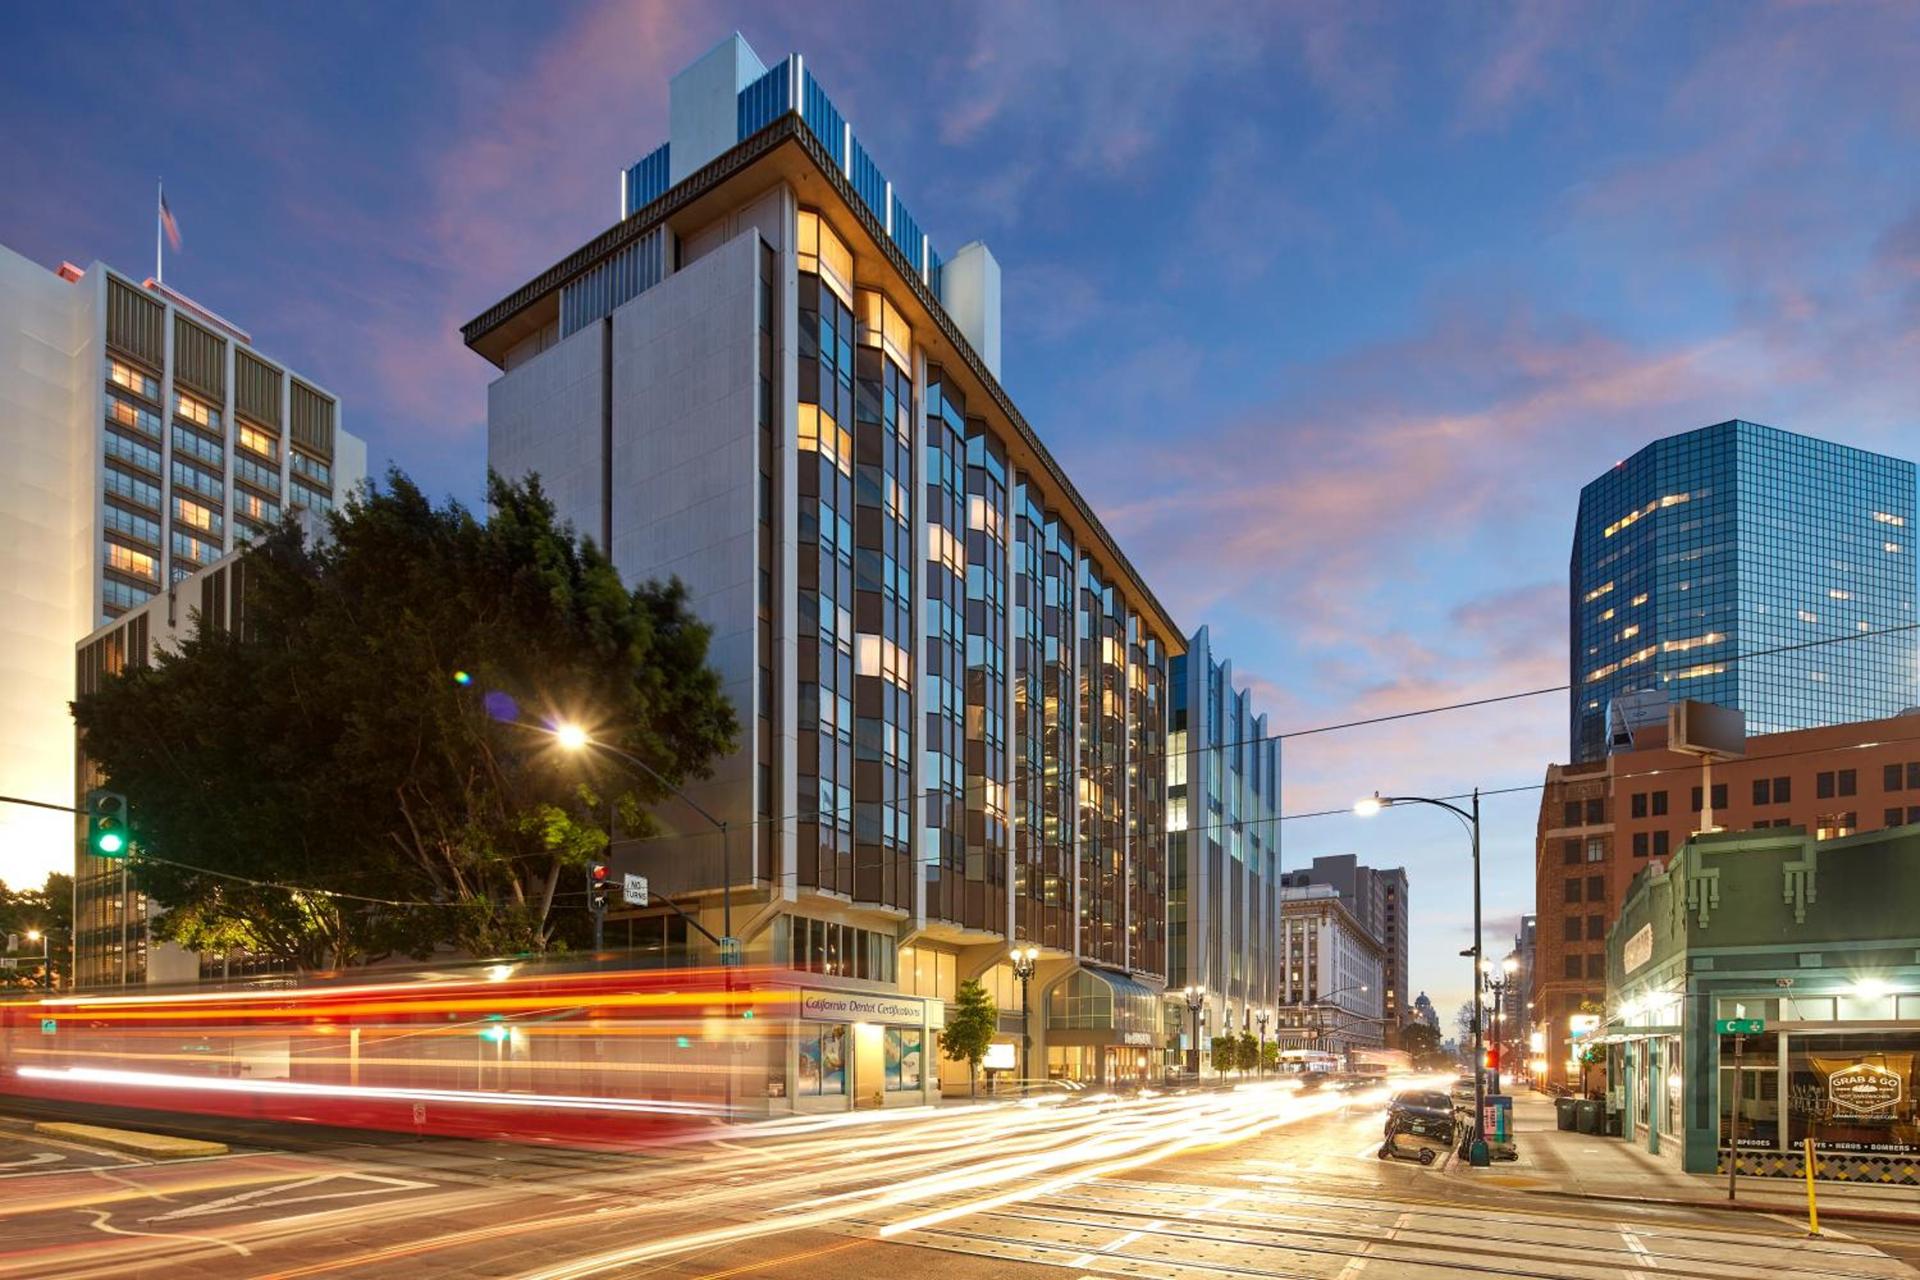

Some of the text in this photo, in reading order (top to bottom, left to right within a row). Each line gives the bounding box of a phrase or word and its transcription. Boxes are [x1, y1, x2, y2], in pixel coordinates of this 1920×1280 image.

[626, 890, 647, 900] TURNS
[805, 997, 846, 1012] California
[849, 1000, 875, 1013] Dental
[1726, 1021, 1737, 1032] C
[1832, 1075, 1898, 1087] GRAB & GO
[1871, 1143, 1910, 1152] BOMBERS
